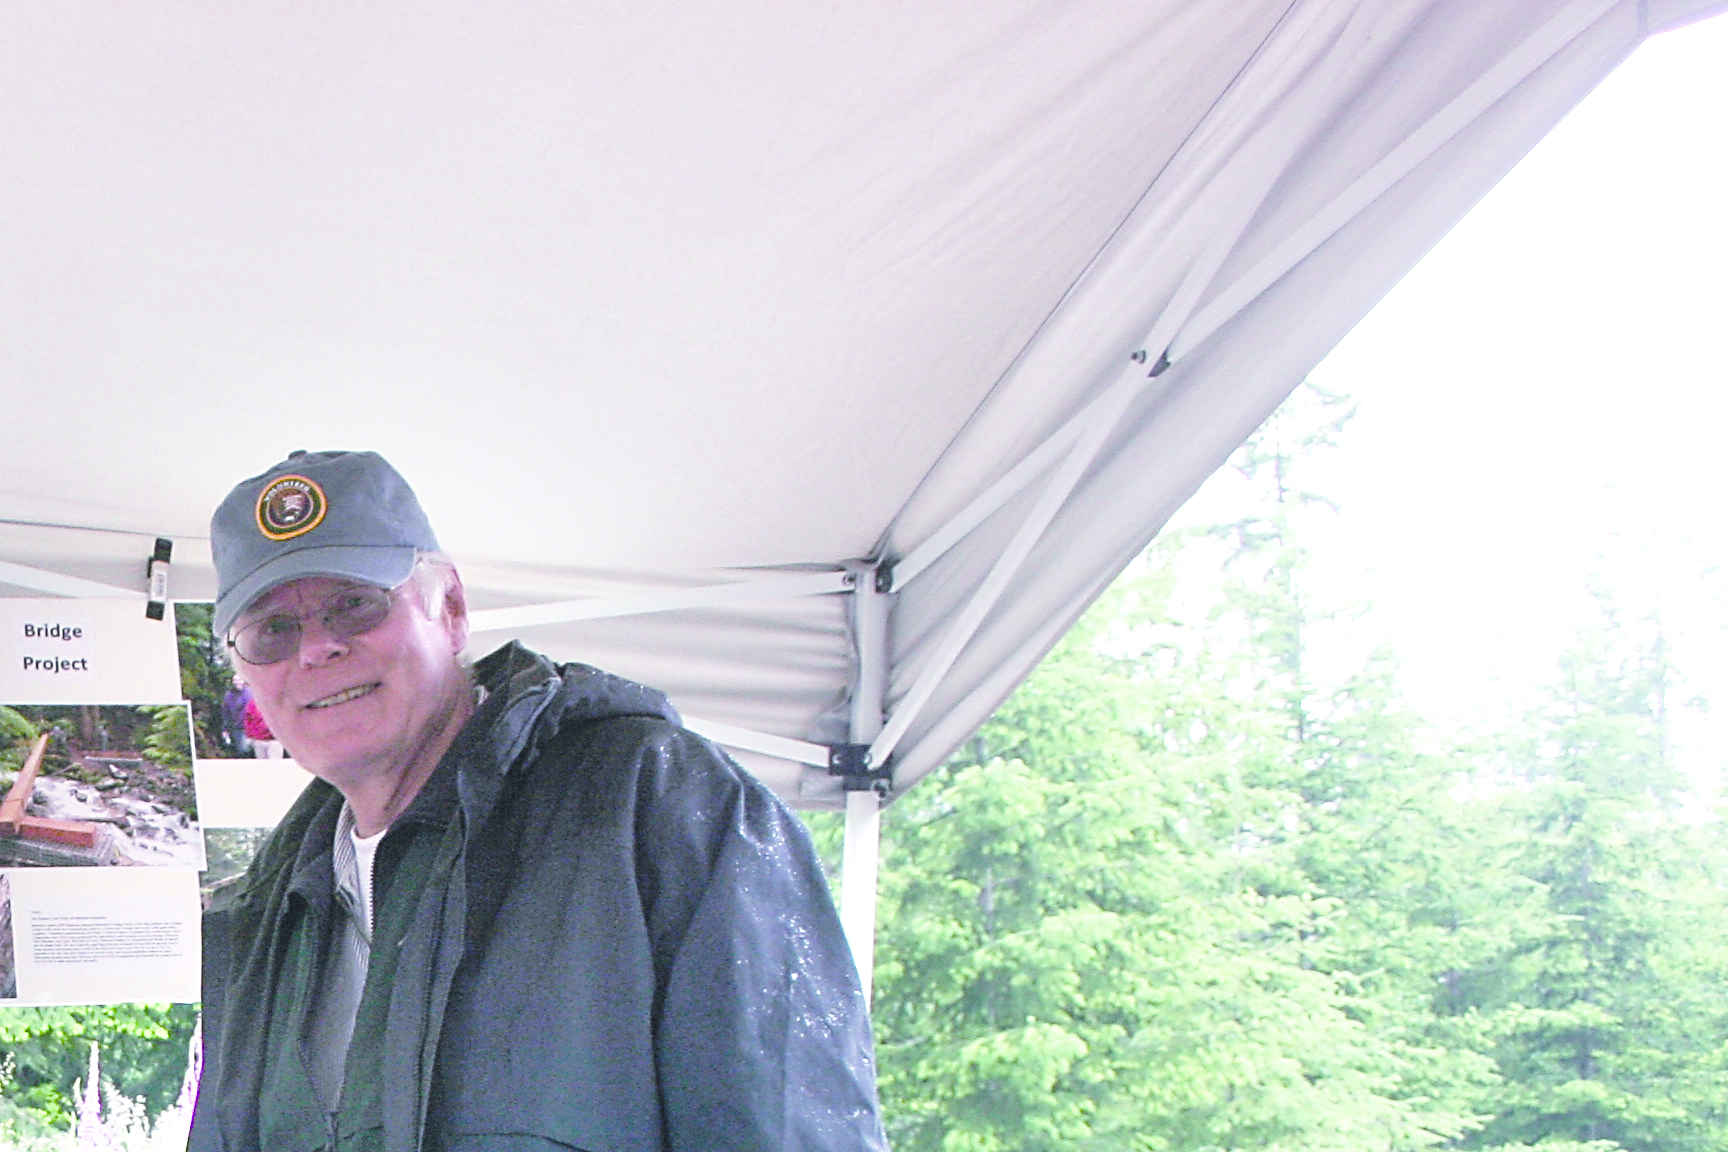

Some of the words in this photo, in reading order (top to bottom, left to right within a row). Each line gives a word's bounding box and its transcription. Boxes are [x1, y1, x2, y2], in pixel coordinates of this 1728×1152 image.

[264, 480, 311, 502] VOLUNTEER
[24, 623, 82, 641] Bridge
[23, 656, 88, 674] Project
